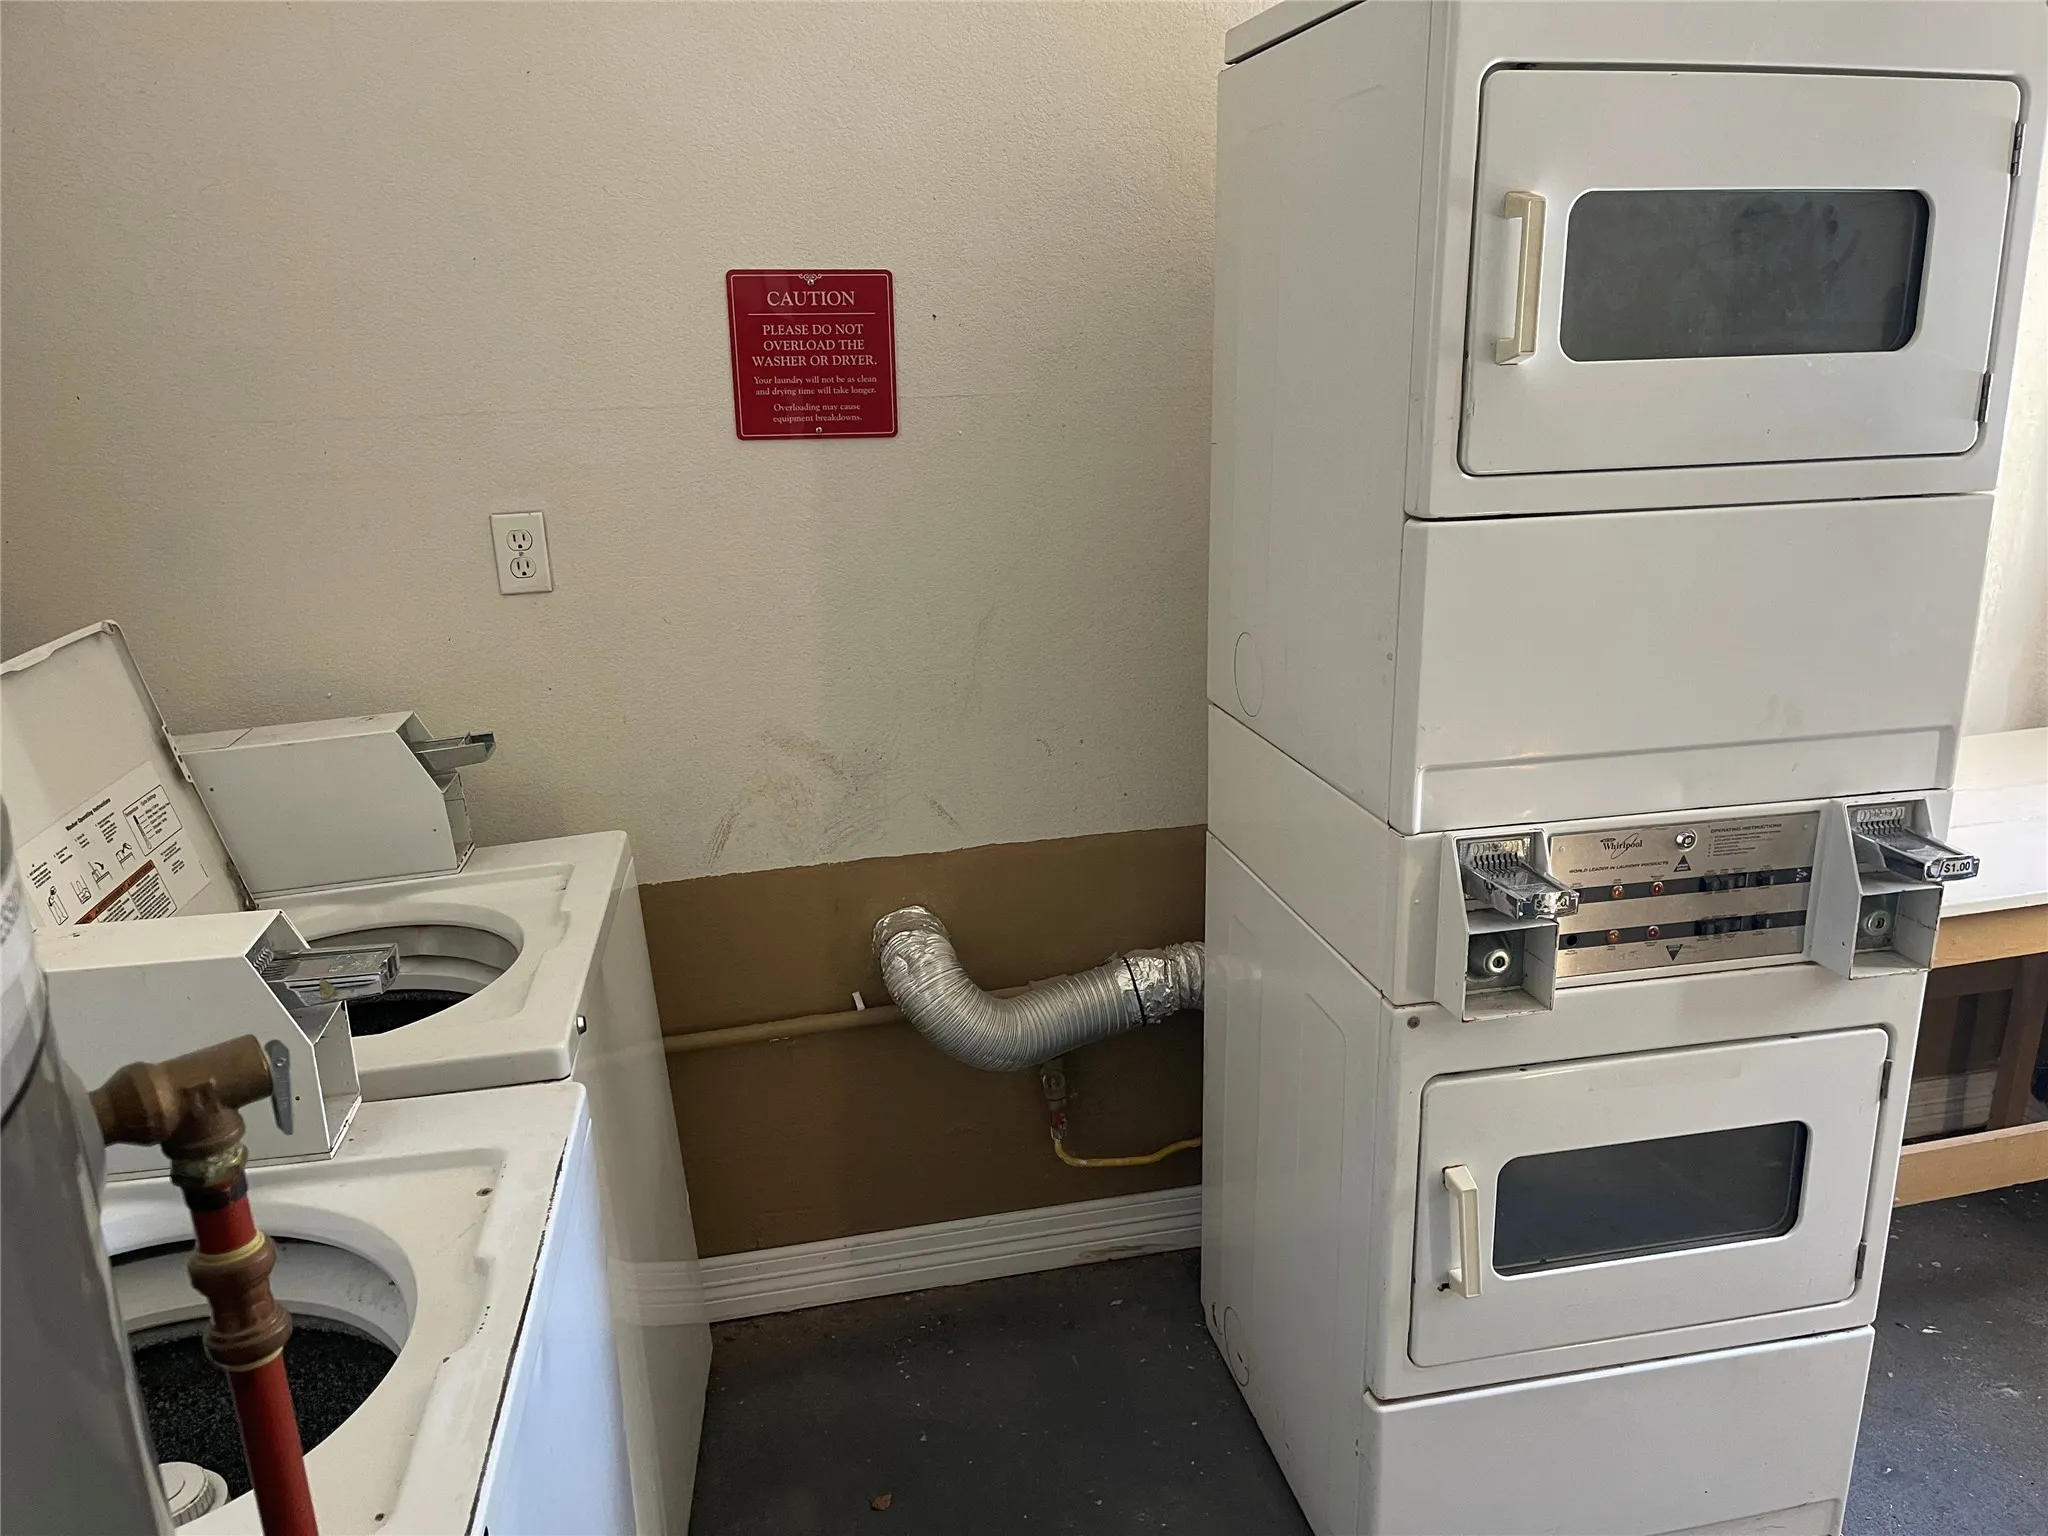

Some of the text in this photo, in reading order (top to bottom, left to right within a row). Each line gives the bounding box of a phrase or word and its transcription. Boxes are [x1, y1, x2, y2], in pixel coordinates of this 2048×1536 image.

[767, 290, 855, 306] CAUTION
[762, 324, 864, 335] PLEASE DO NOT
[763, 339, 865, 351] OVERLOAD THE
[752, 355, 877, 367] WASHER OR DRYER.
[754, 376, 772, 385] Your
[774, 376, 803, 385] laundry
[836, 375, 846, 383] be
[857, 375, 877, 383] clean
[755, 388, 770, 396] and
[771, 387, 797, 396] drying
[798, 387, 815, 395] time
[851, 386, 877, 396] longer.
[773, 403, 820, 412] Overloading
[822, 404, 838, 412] may
[773, 414, 862, 424] equipment breakdowns.
[1710, 823, 1783, 834] OPERATING INSTRUCTIONS
[1602, 839, 1643, 853] Whirlpool
[1641, 860, 1669, 868] PRODUCTS
[1944, 861, 1970, 873] $1.00
